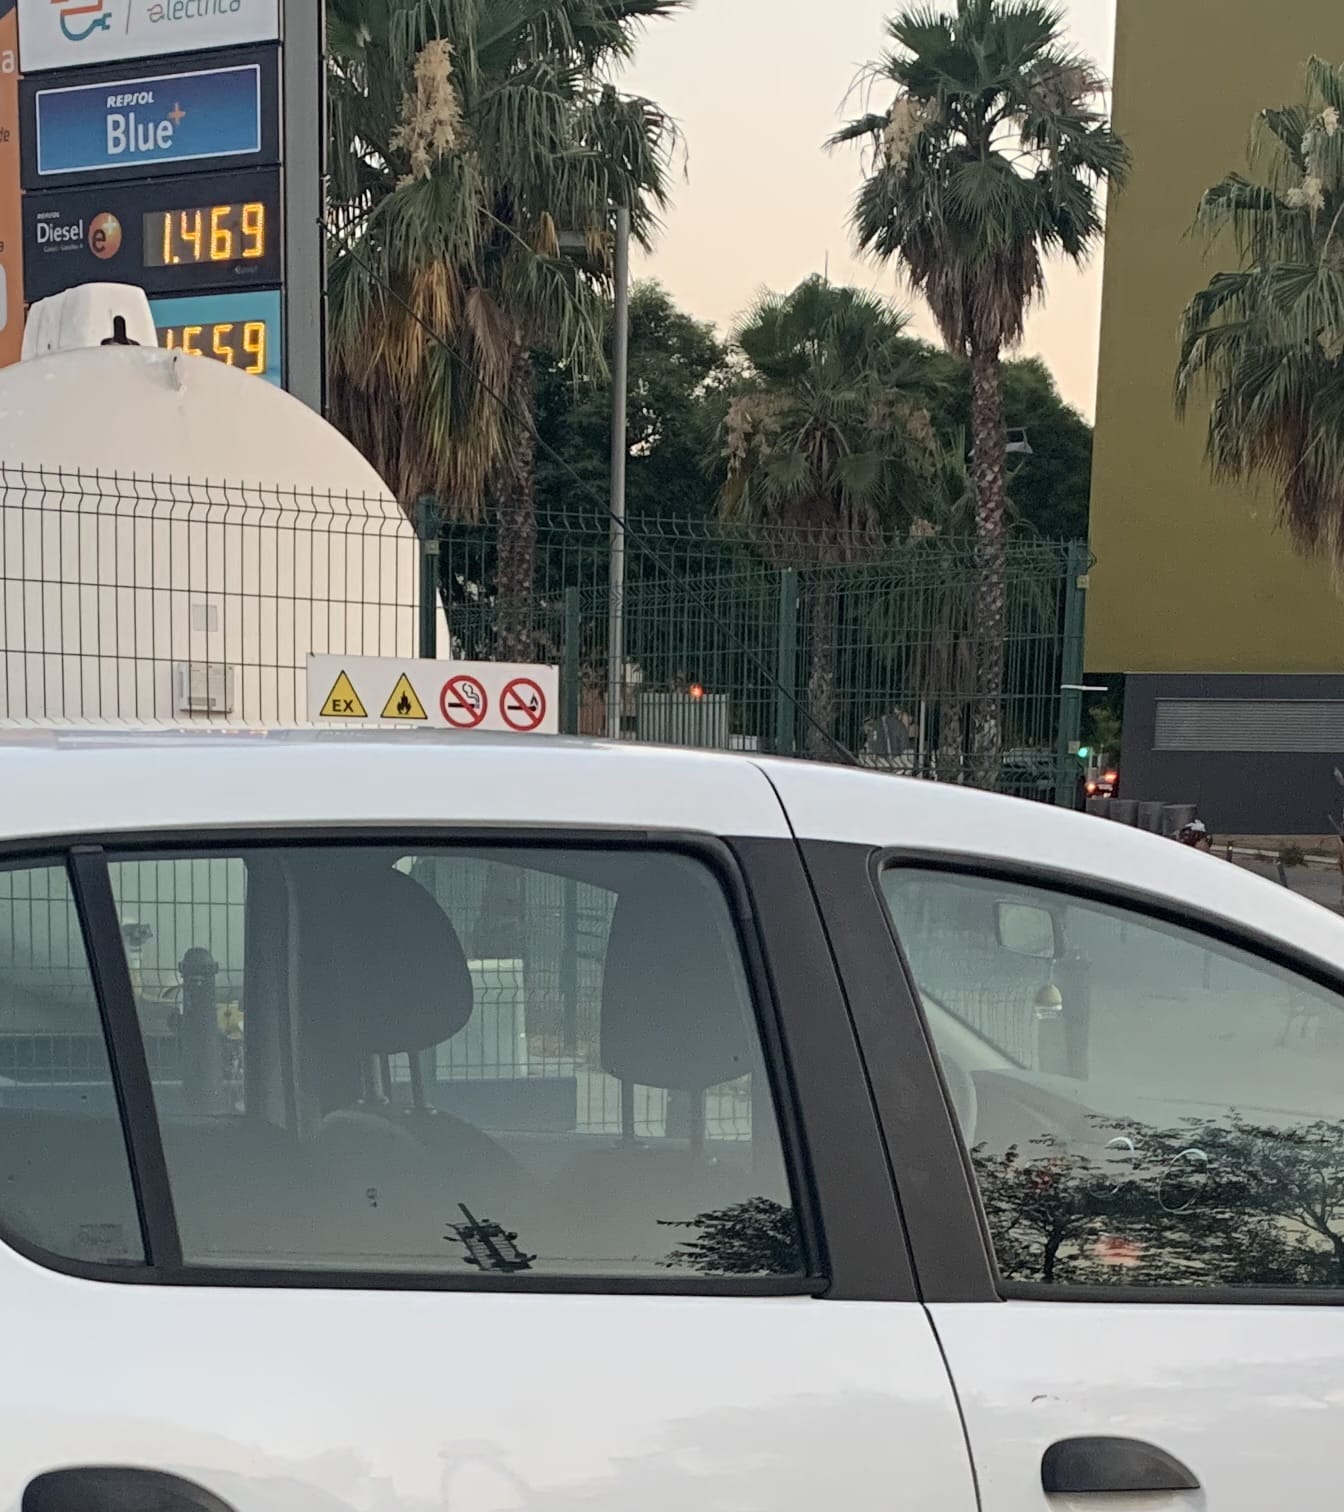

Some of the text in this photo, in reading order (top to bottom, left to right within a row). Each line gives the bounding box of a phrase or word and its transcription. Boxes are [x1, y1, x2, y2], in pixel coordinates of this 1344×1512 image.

[107, 91, 154, 108] REPSOL
[37, 219, 84, 243] Diesel
[164, 202, 264, 264] 1.469
[332, 699, 354, 713] EX
